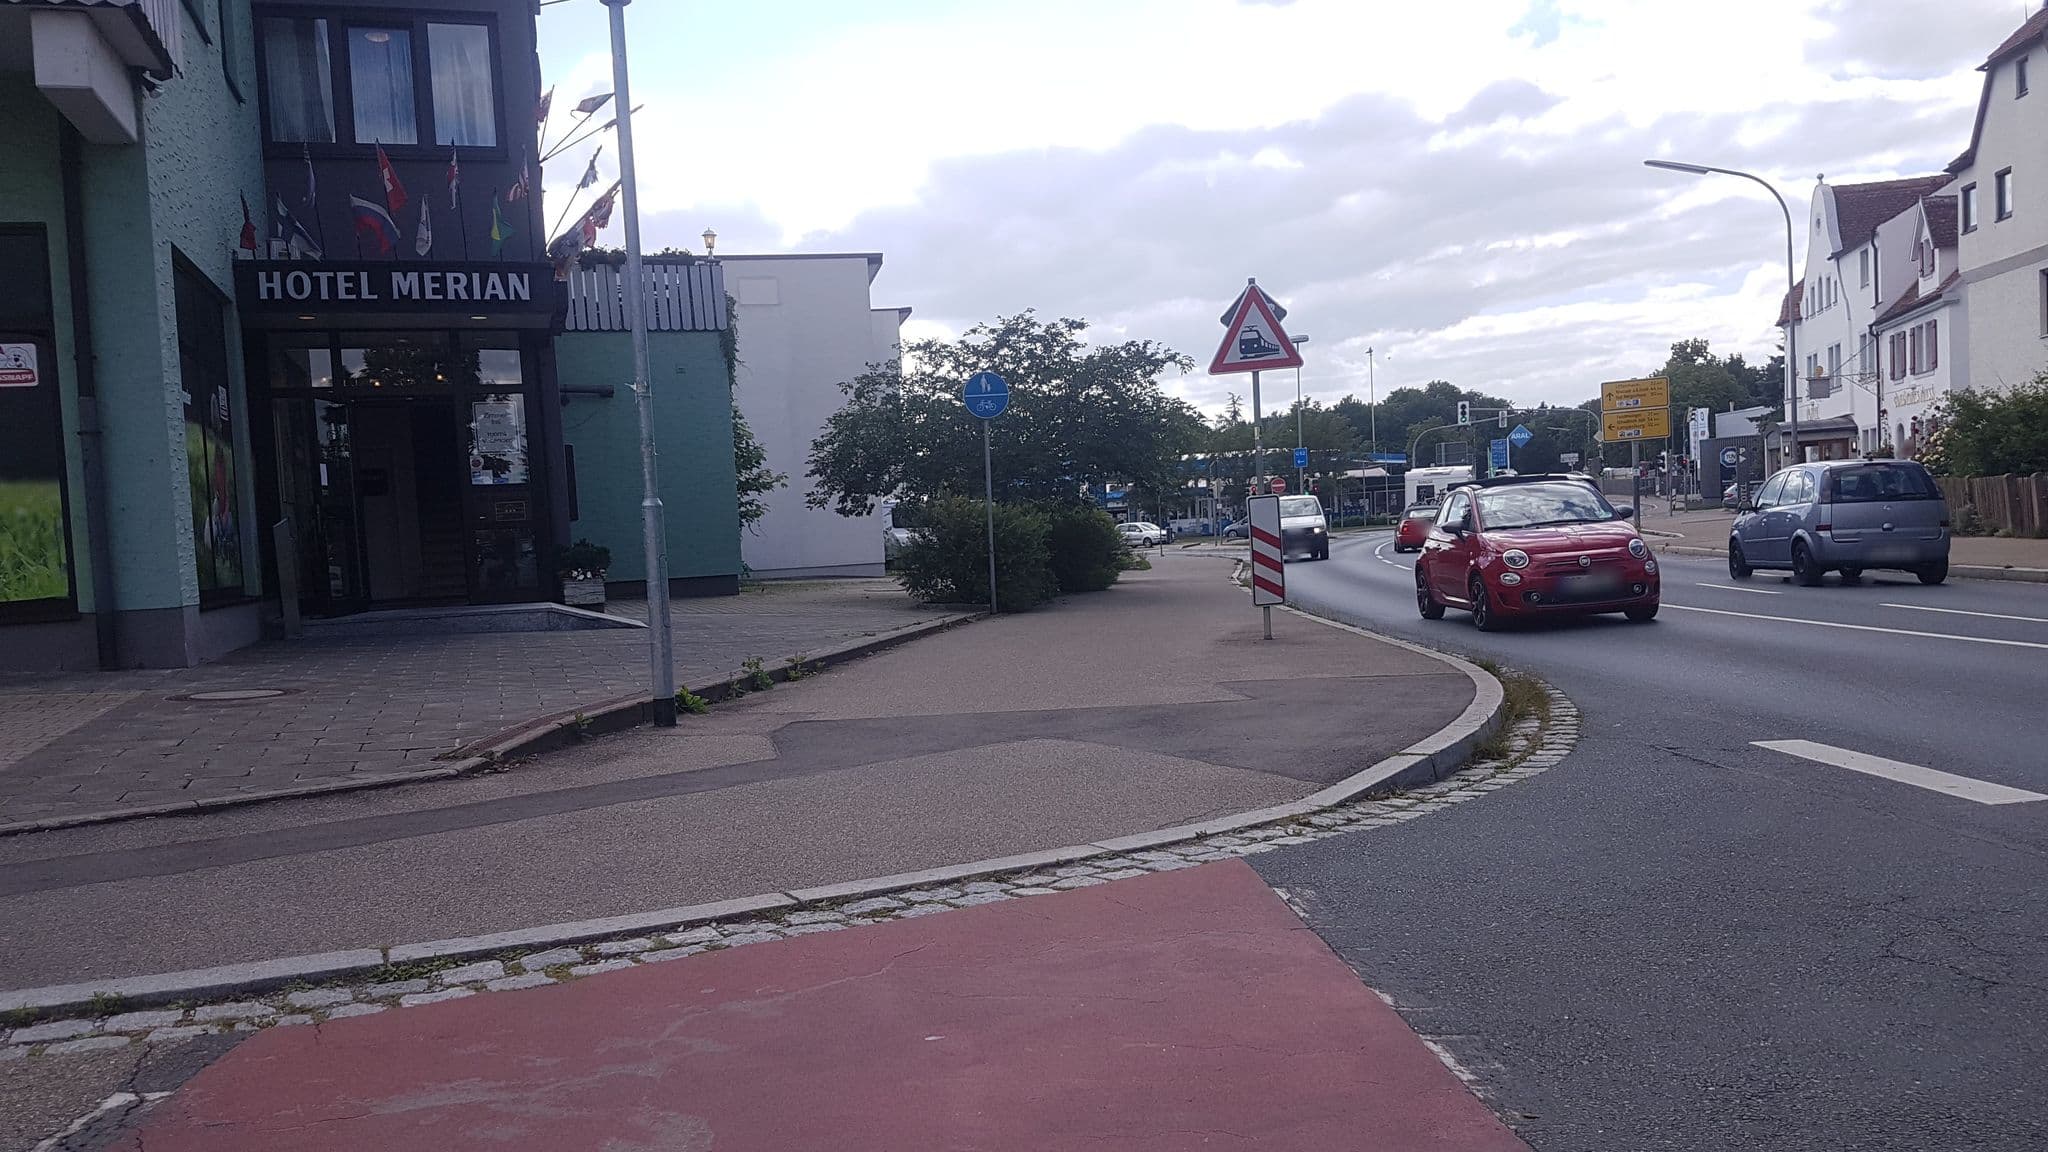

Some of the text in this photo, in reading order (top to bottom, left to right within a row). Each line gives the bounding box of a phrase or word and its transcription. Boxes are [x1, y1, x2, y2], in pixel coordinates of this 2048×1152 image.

[258, 271, 531, 301] HOTEL MERIAN
[1511, 432, 1530, 440] ARAL
